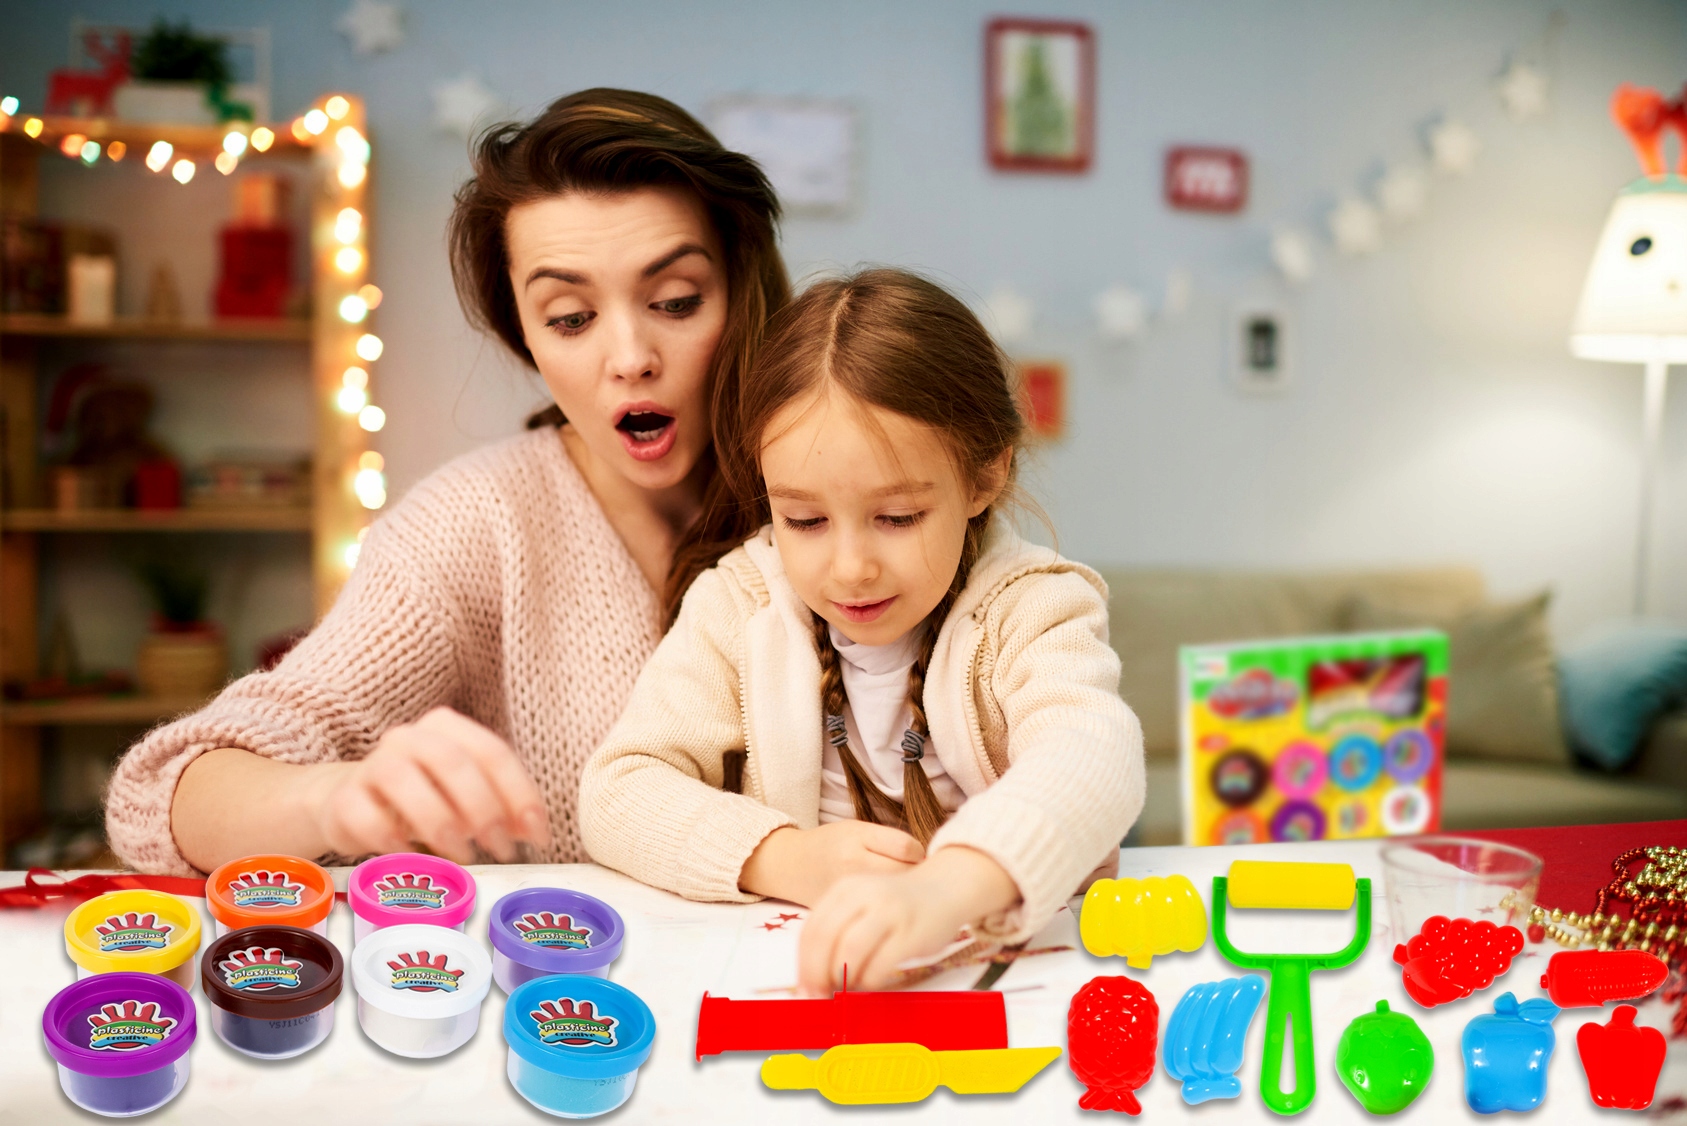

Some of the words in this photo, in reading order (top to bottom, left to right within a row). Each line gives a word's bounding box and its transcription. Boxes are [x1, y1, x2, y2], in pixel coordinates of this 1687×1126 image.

[240, 890, 293, 898] plasticine
[384, 891, 440, 899] plasticine
[105, 932, 163, 942] plasticine
[527, 932, 583, 940] plasticine
[234, 968, 293, 979] plasticine
[395, 970, 455, 982] plasticine
[97, 1025, 161, 1036] plasticine
[544, 1022, 606, 1032] plasticine
